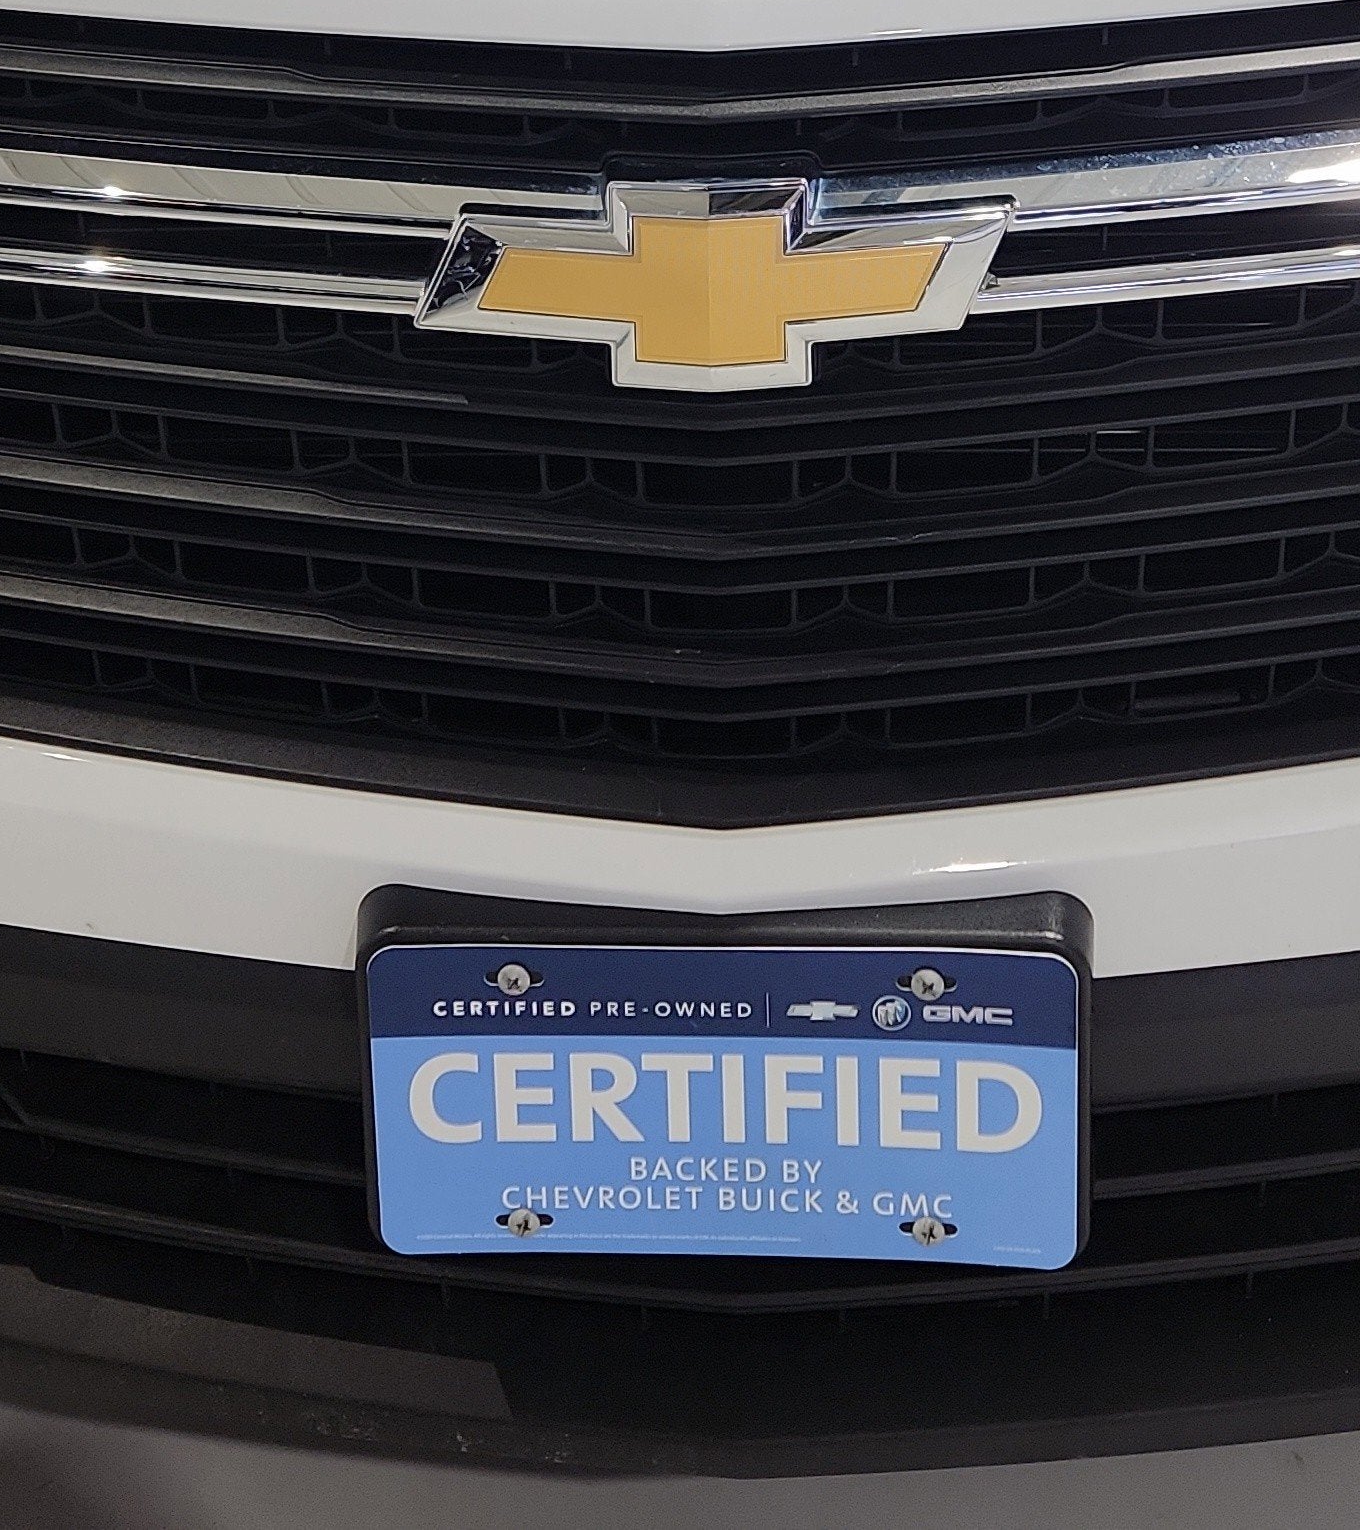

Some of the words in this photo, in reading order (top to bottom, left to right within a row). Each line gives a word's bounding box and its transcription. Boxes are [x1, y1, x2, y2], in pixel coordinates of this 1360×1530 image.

[432, 999, 577, 1018] CERTIFIED
[589, 1000, 753, 1019] PRE-OWNED
[921, 1004, 1014, 1027] GMC
[407, 1050, 1044, 1154] CERTIFIED
[630, 1156, 767, 1183] BACKED
[782, 1157, 824, 1184] BY
[501, 1185, 704, 1212] CHEVROLET
[717, 1186, 825, 1214] BUICK
[835, 1190, 860, 1215] &
[871, 1190, 954, 1219] GMC
